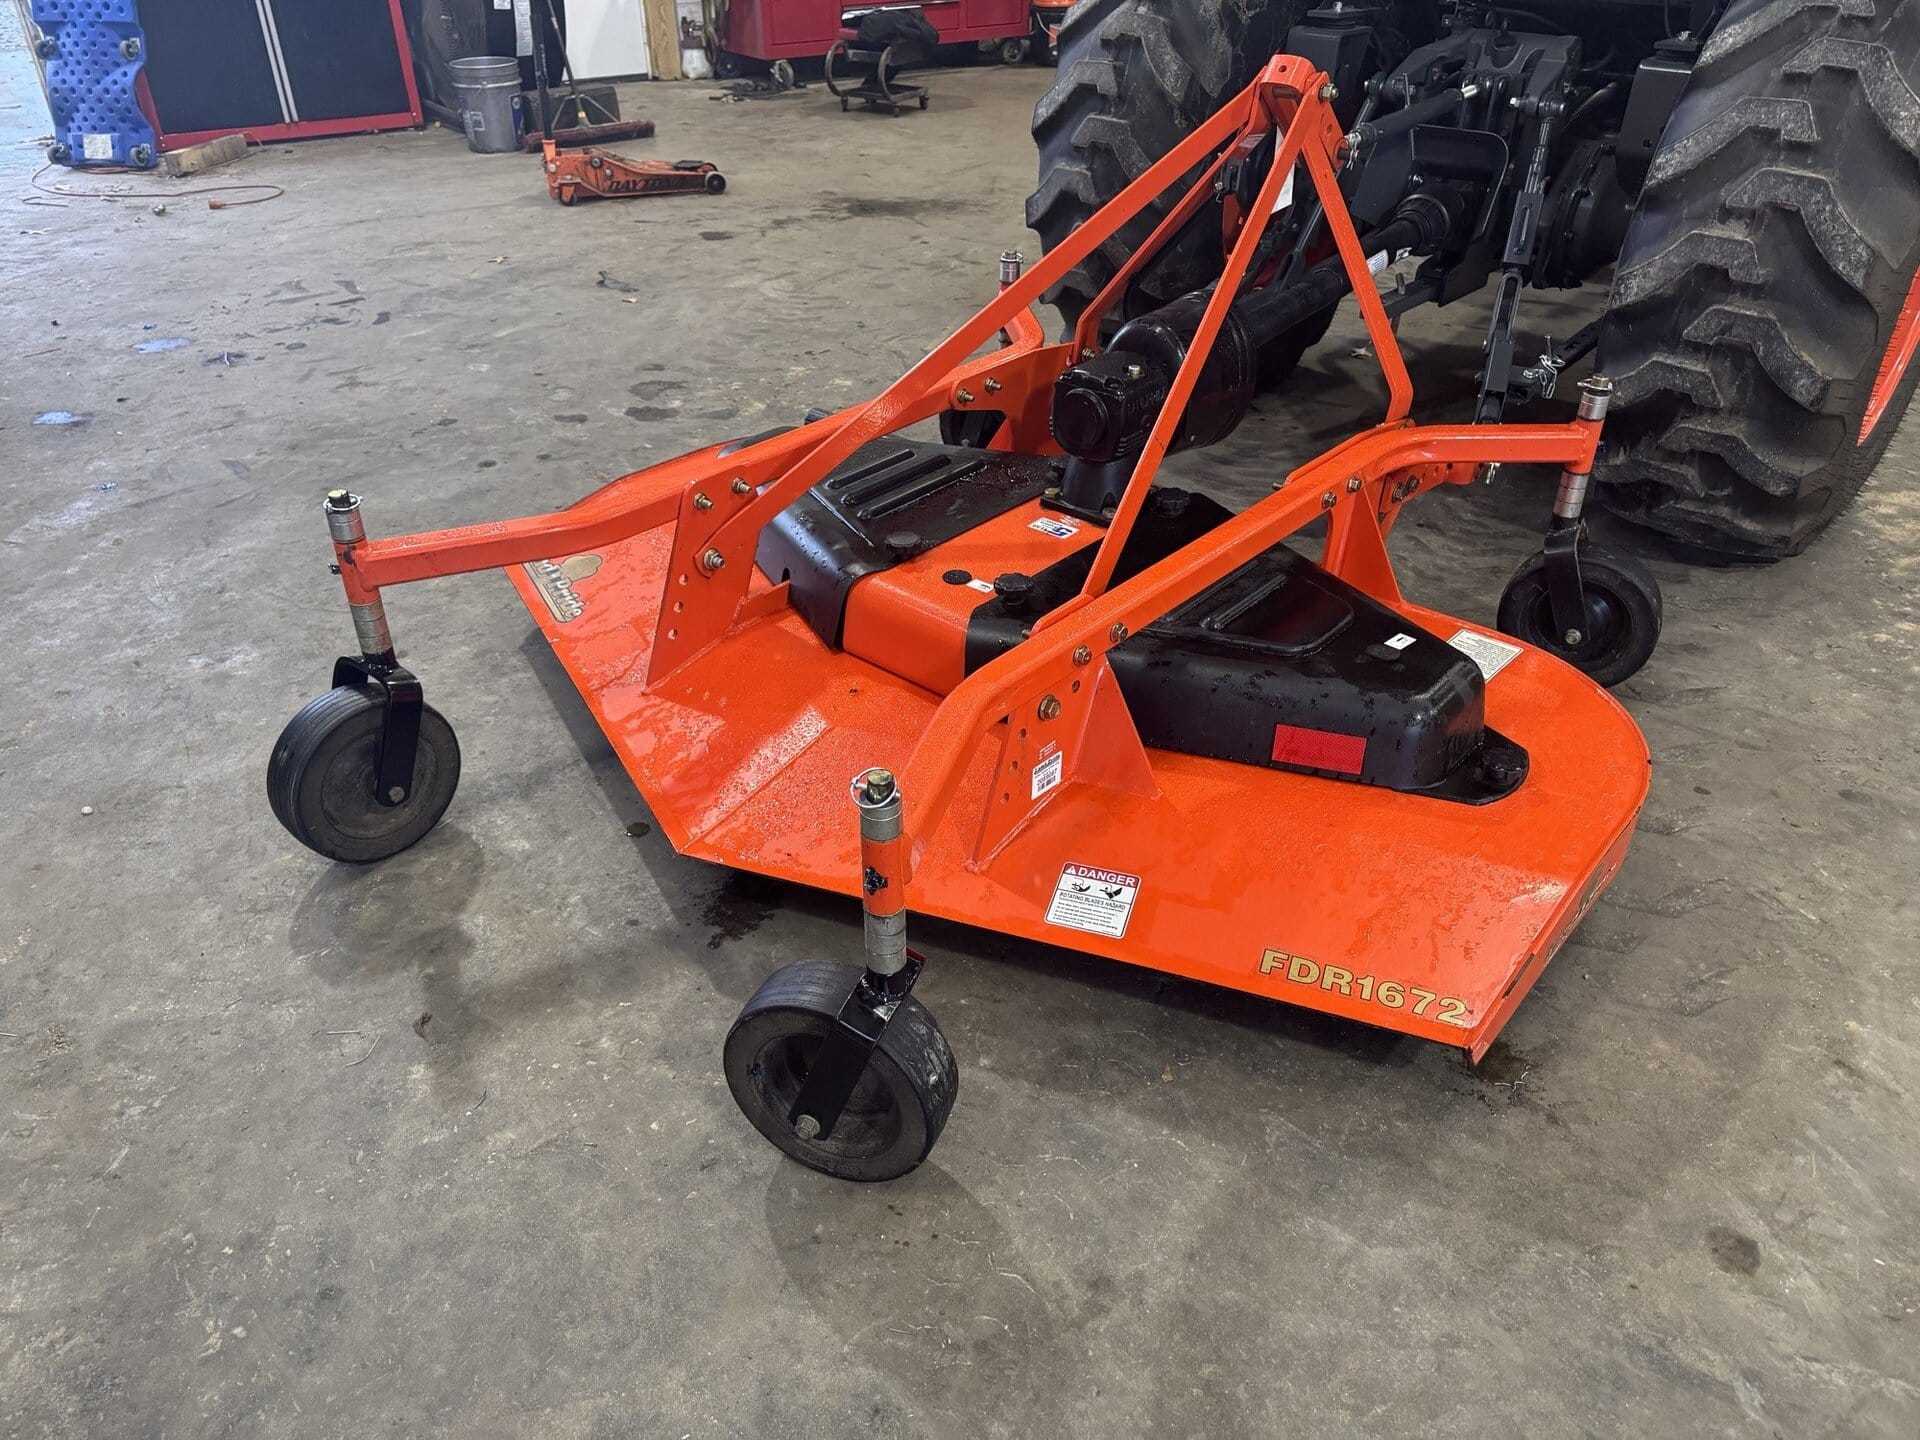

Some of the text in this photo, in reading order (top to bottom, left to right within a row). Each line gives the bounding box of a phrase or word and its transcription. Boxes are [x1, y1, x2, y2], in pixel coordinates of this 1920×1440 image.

[1078, 867, 1136, 887] DANGER
[1059, 891, 1084, 902] ROTATING
[1104, 901, 1126, 910] HAZARD
[1258, 948, 1467, 1026] FDR1672
